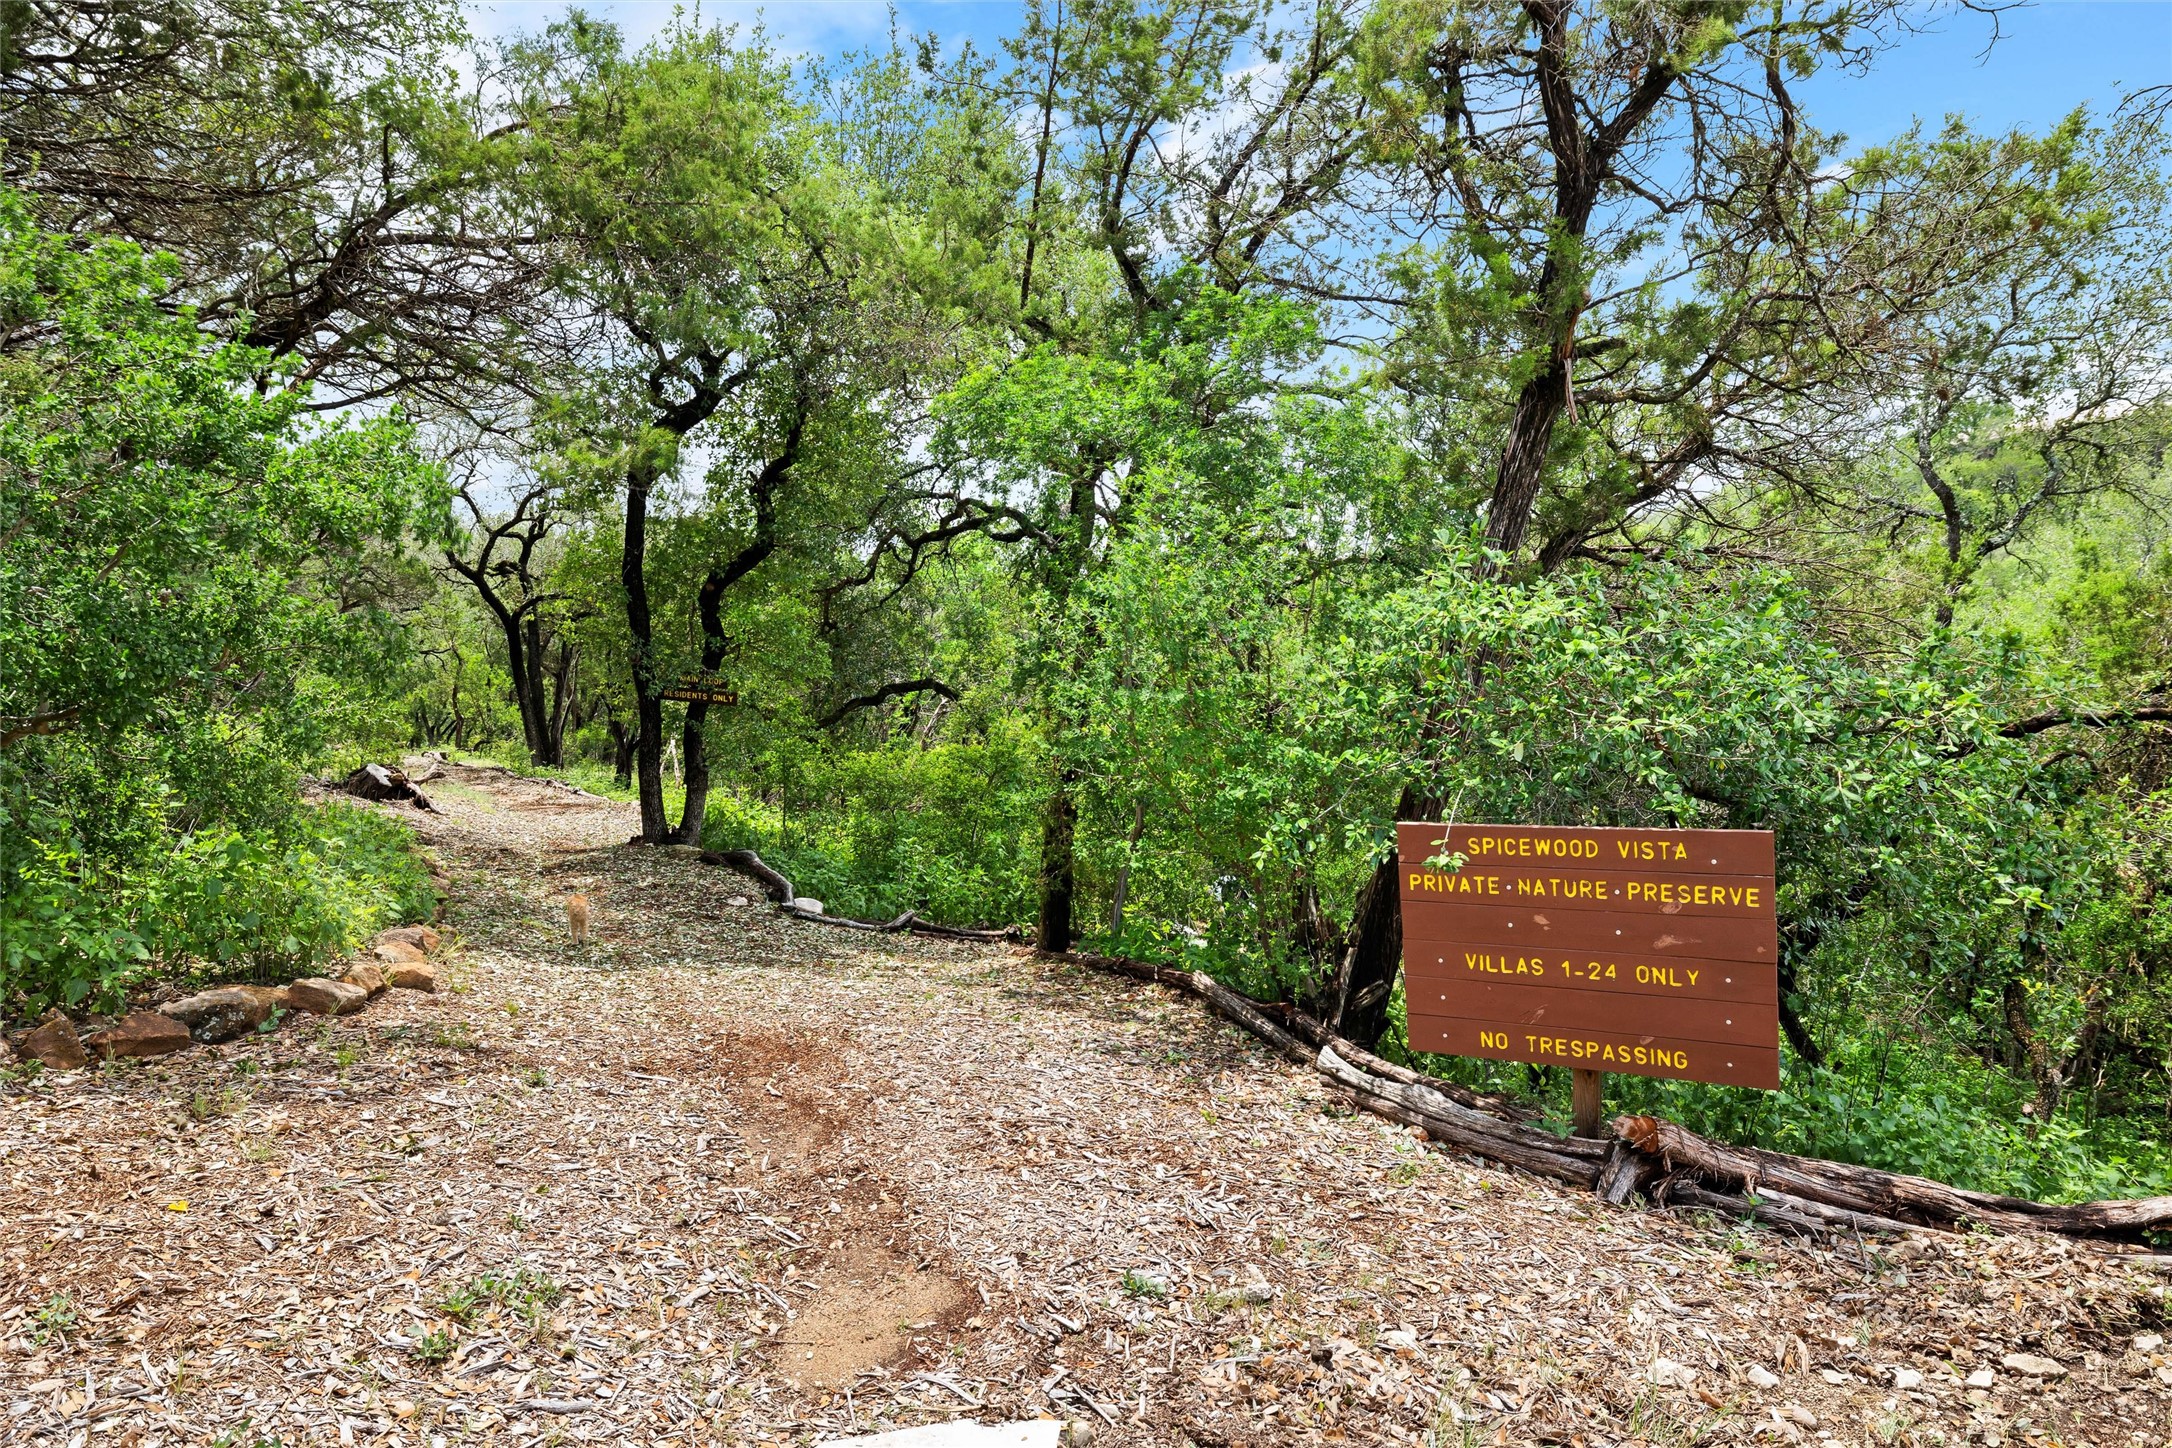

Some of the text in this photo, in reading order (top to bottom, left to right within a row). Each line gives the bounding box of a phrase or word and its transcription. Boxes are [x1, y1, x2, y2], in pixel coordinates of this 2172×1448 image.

[664, 690, 707, 699] RESIDENTS
[1468, 838, 1687, 860] SPICEWOOD VISTA
[1409, 874, 1760, 908] PRIVATE NATURE PRESERVE
[1465, 953, 1700, 987] VILLAS 1-24 ONLY
[1480, 1031, 1688, 1069] NO TRESPASSING
